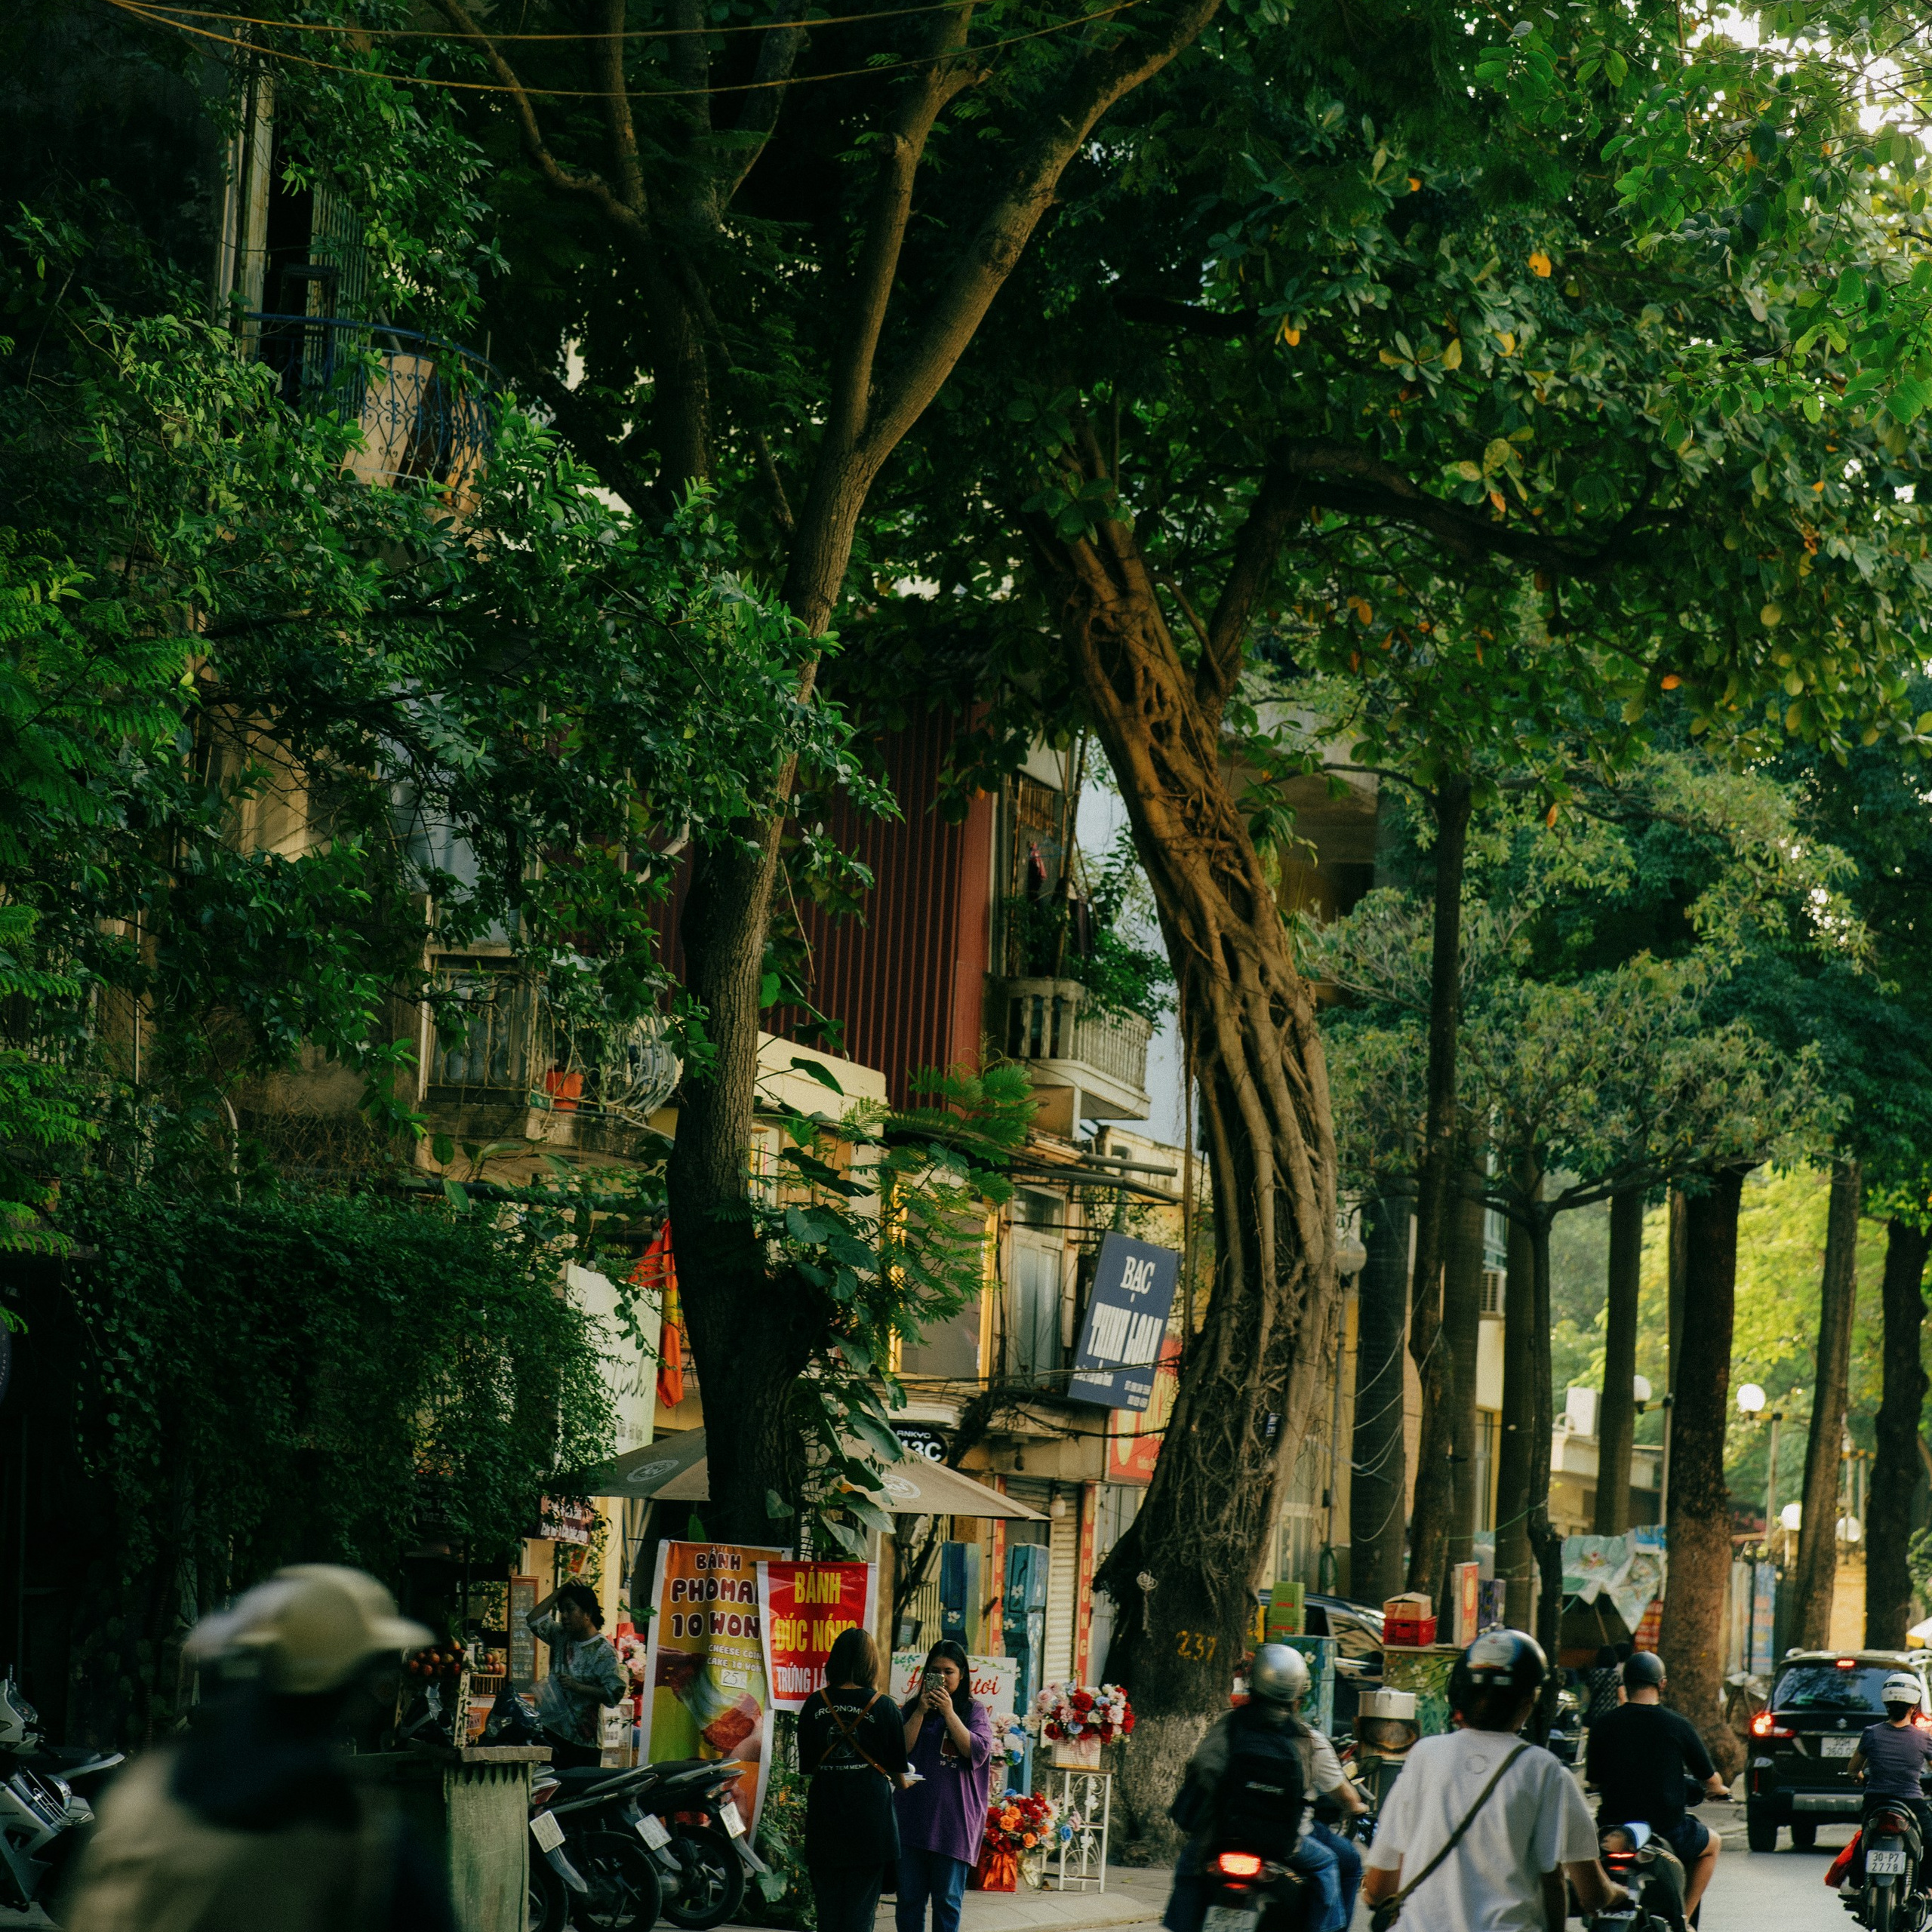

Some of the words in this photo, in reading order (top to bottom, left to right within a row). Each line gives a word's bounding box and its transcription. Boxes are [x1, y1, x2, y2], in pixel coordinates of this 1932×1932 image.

[794, 1565, 841, 1604] BÁNH
[671, 1612, 703, 1639] 10
[709, 1611, 761, 1640] WON
[708, 1644, 740, 1657] CHEESE
[1176, 1630, 1217, 1662] 237
[707, 1657, 728, 1668] CAKE
[1872, 1852, 1900, 1863] 30-P7
[1872, 1862, 1899, 1872] 2778
